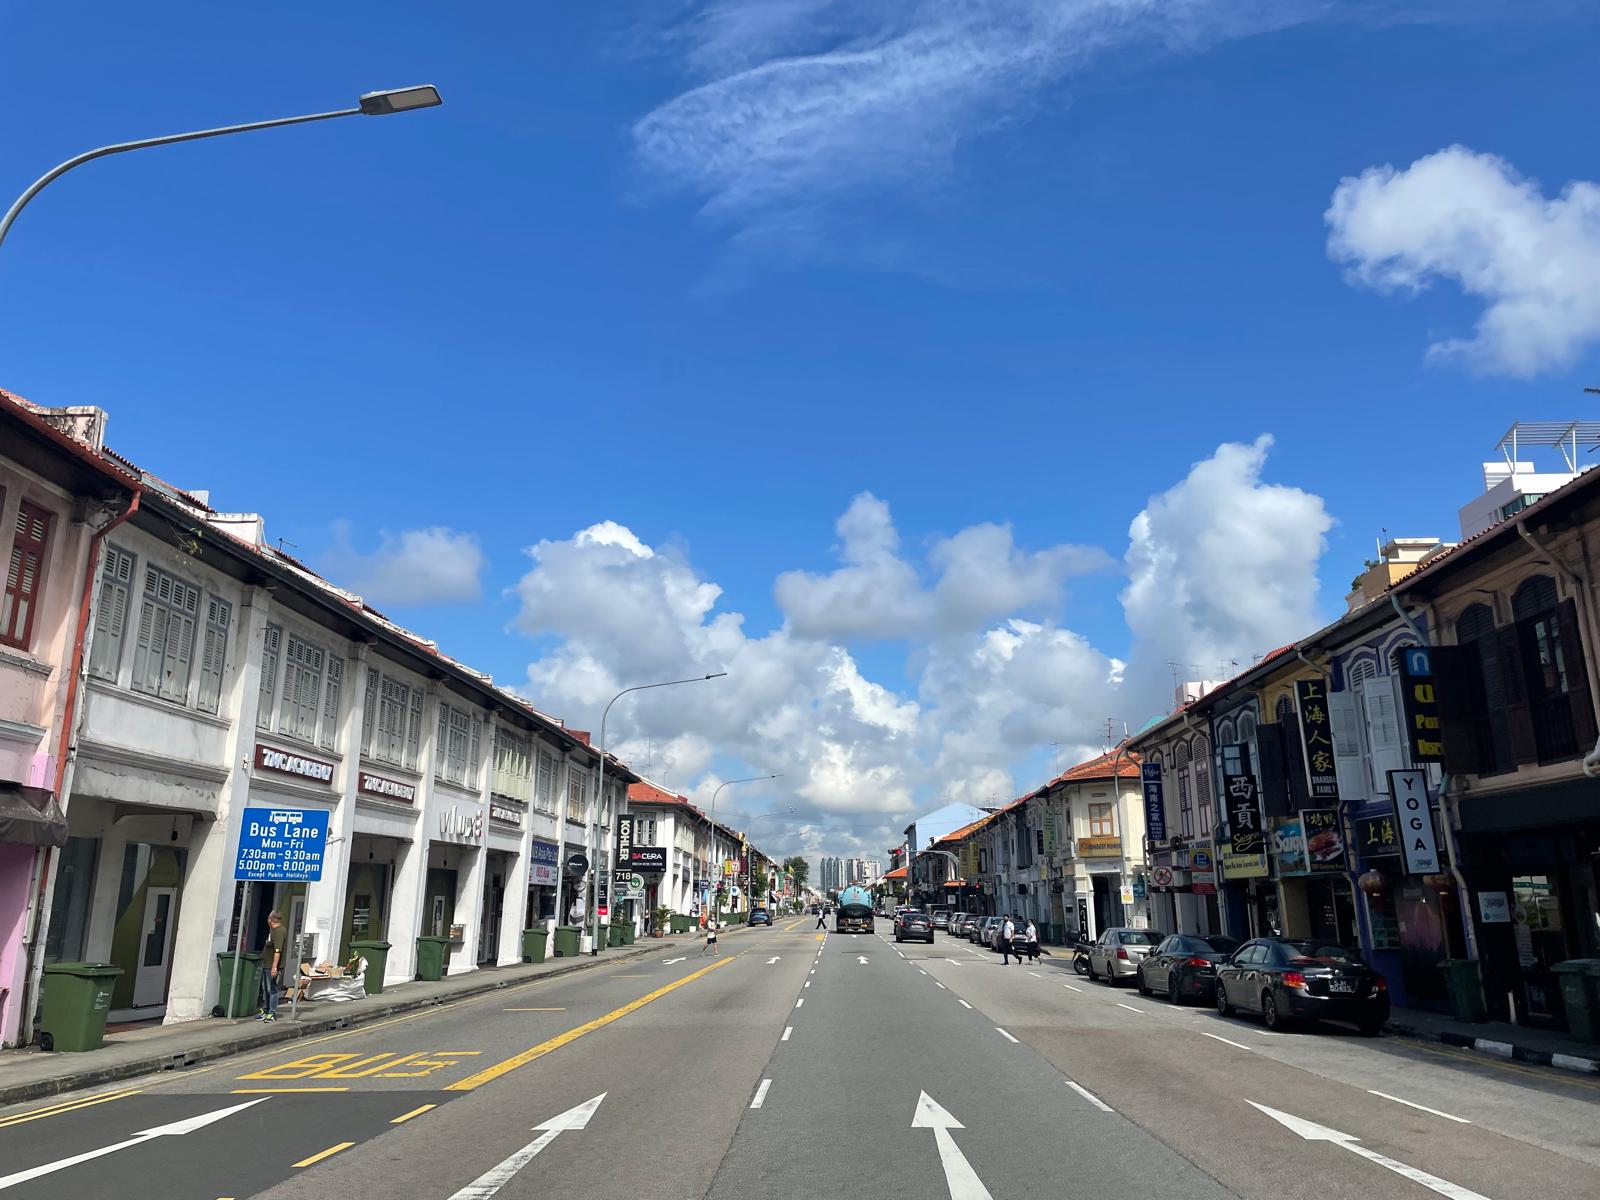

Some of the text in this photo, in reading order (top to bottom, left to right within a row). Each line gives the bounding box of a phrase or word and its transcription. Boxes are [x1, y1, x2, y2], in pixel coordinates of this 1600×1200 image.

[1303, 683, 1333, 772] 上海人家
[262, 748, 333, 781] TMC ACADEMY
[1229, 776, 1257, 829] 西貢
[1403, 778, 1426, 851] YOGA
[249, 822, 319, 838] Bus Lane
[620, 820, 630, 861] KOHLER
[1275, 831, 1304, 856] Saigo
[616, 872, 631, 880] 718
[234, 1052, 482, 1079] BUS
